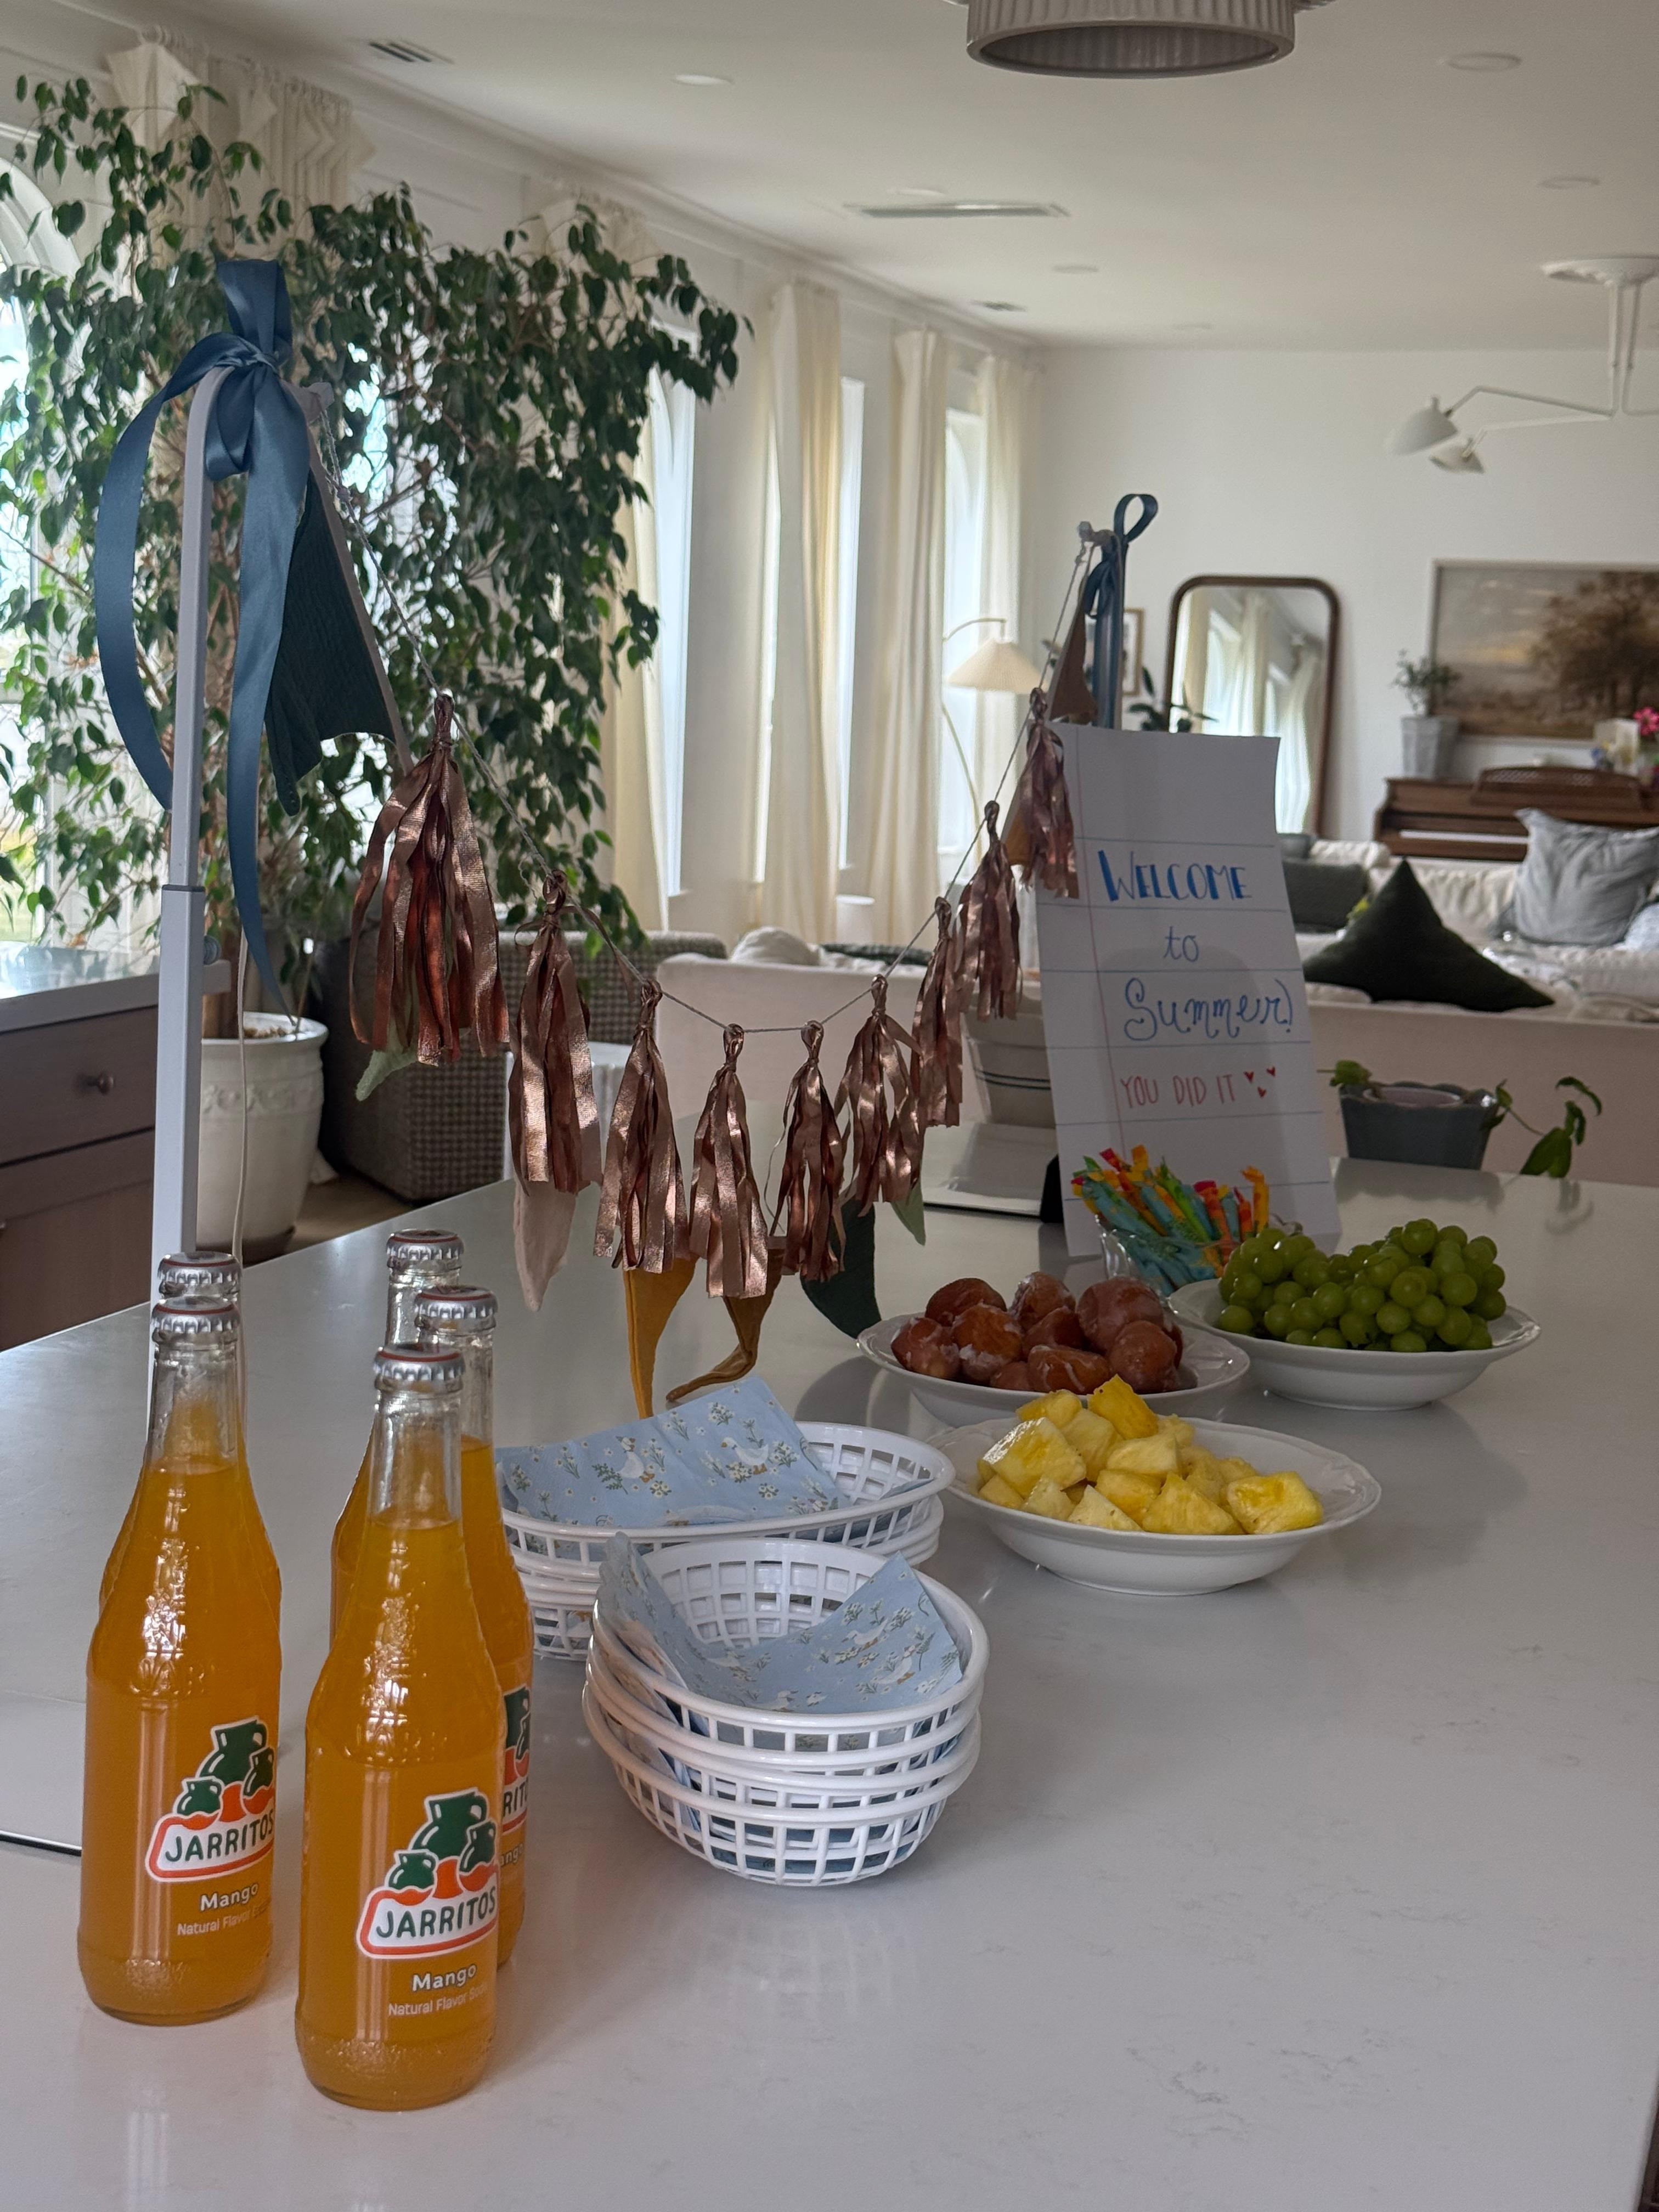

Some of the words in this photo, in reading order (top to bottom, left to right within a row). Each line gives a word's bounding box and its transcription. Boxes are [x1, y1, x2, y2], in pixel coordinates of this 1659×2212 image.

[1097, 849, 1251, 902] WELCOME
[1163, 926, 1200, 962] to
[1120, 1075, 1159, 1109] YOU
[1172, 1075, 1207, 1107] DID
[1215, 1073, 1236, 1104] IT
[165, 1808, 274, 1862] JARRITOS
[200, 1882, 259, 1911] Mango
[376, 1885, 496, 1939] JARRITOS
[177, 1917, 220, 1936] Natural
[411, 1963, 477, 1992] Mango
[388, 2000, 433, 2017] Natural
[436, 1991, 467, 2011] Flavor
